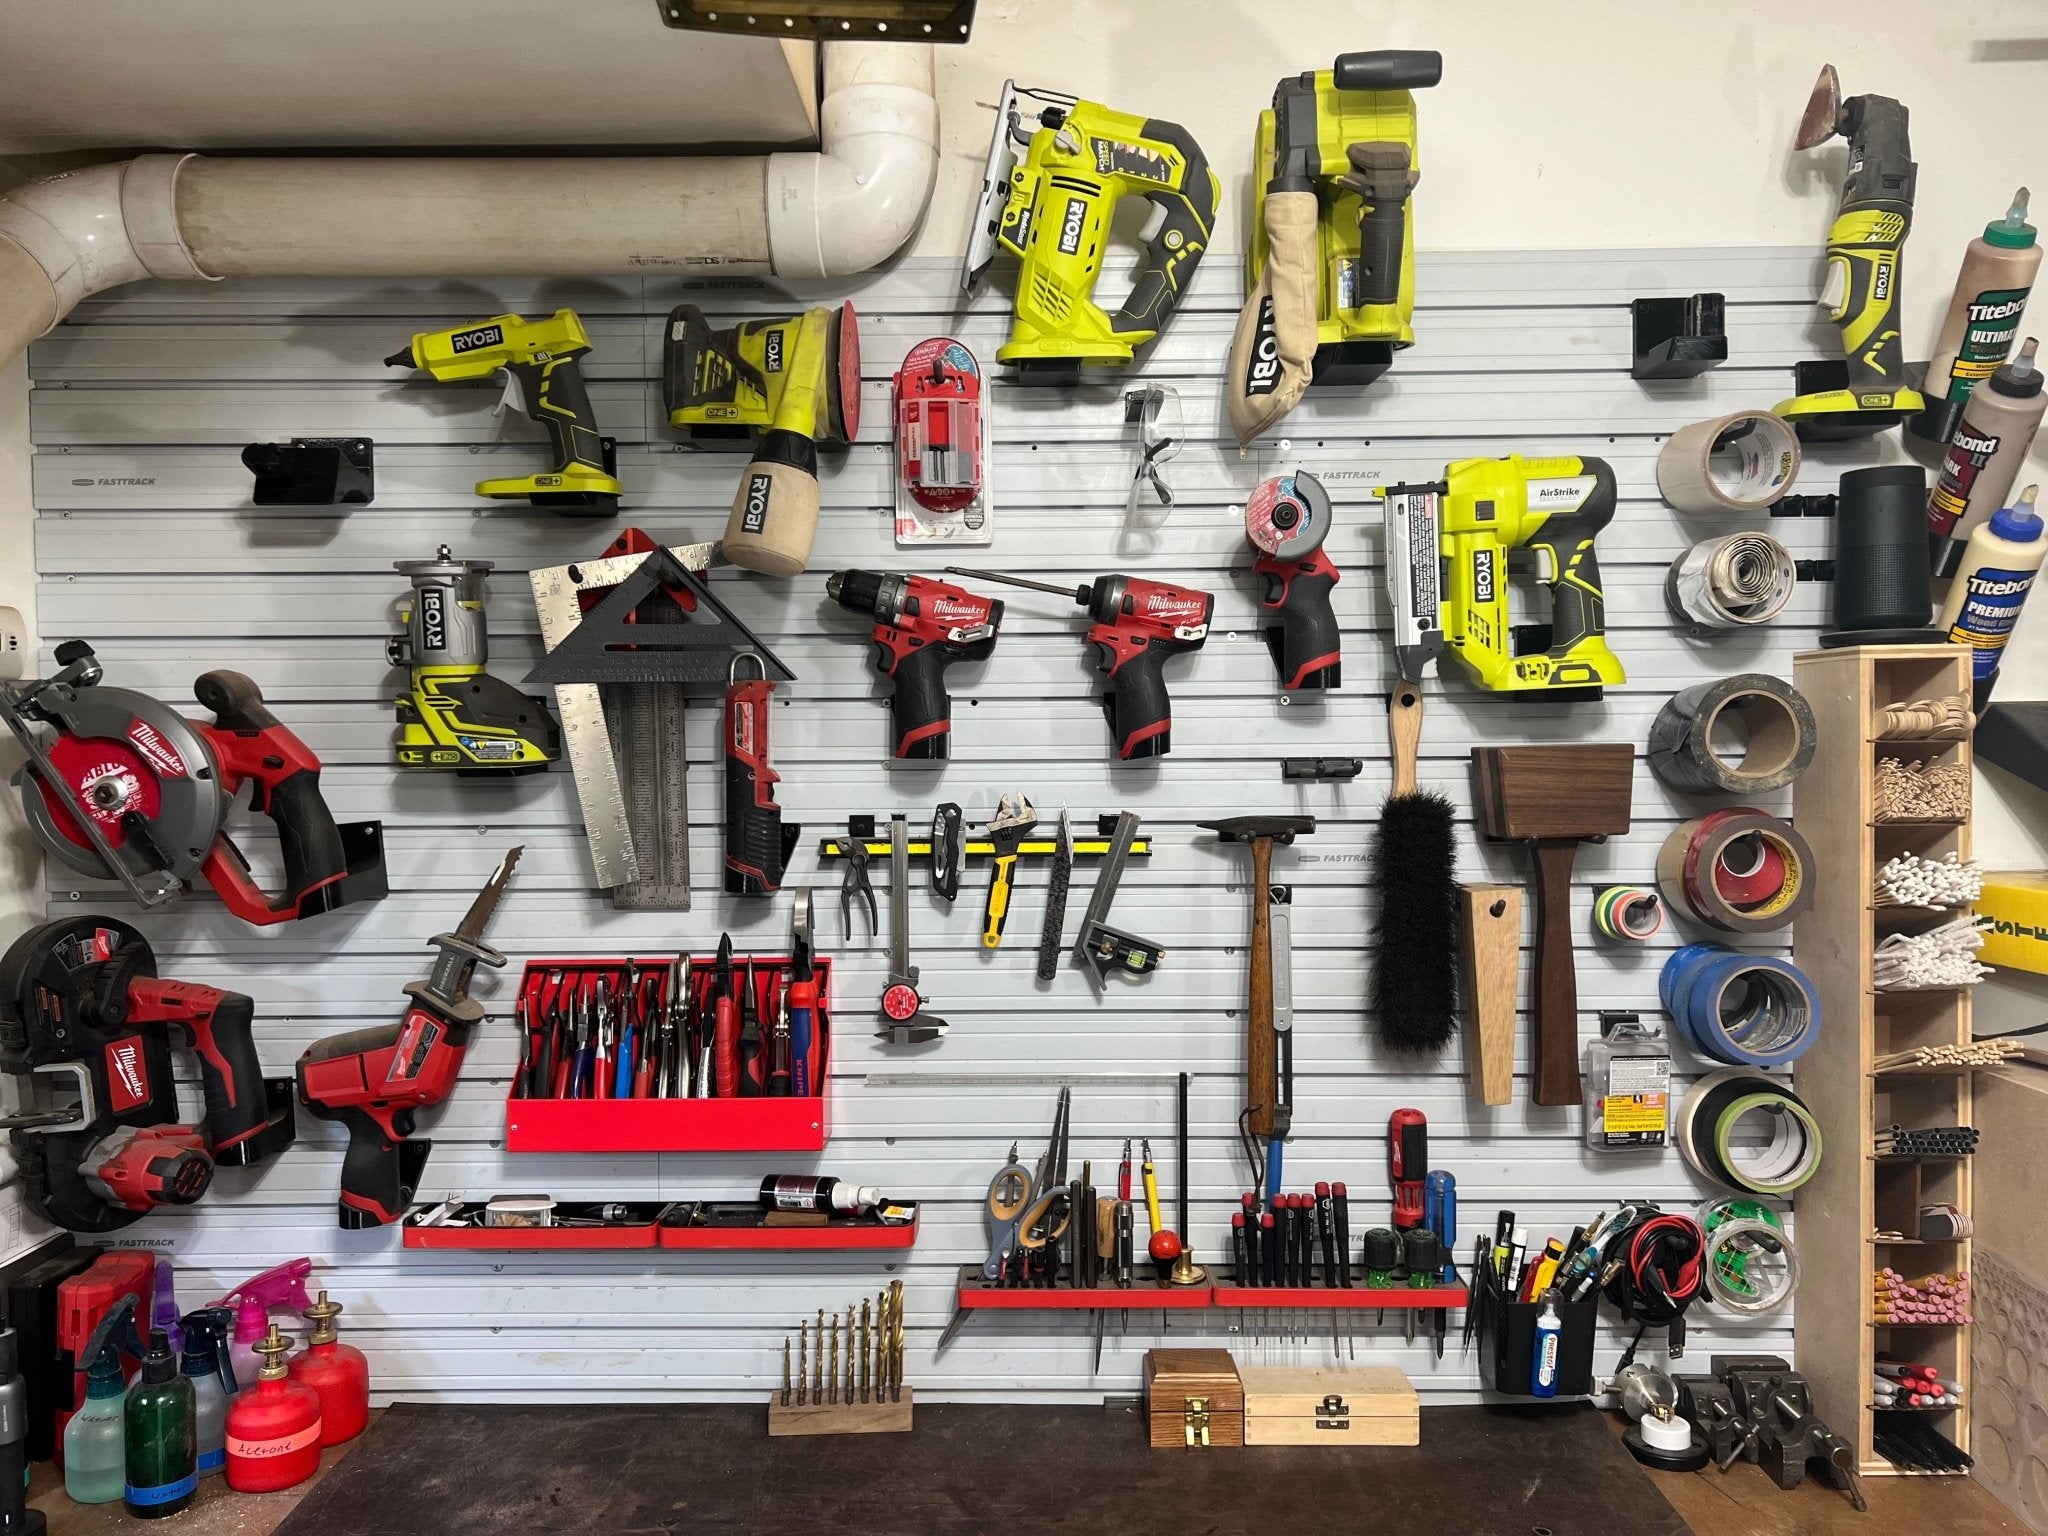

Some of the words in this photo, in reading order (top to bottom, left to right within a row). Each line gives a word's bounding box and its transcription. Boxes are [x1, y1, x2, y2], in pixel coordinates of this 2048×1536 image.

[1097, 141, 1105, 171] MATCH
[1061, 201, 1084, 252] RYOBI
[708, 281, 765, 289] FASTTRACK
[1876, 266, 1889, 298] RYOBI
[454, 328, 500, 350] RYOBI
[1253, 299, 1279, 388] YOBI
[768, 332, 780, 371] RYOBI
[707, 408, 738, 417] ONE+
[98, 478, 156, 486] FASTTRACK
[1323, 471, 1381, 480] FASTTRACK
[1540, 488, 1580, 497] AirStrike
[745, 477, 769, 531] RYOBI
[1477, 553, 1492, 601] RYOBI
[933, 600, 986, 615] Milwaukee
[1148, 594, 1202, 610] Milwaukee
[425, 592, 442, 648] RYOBI
[963, 621, 985, 629] FUEL
[1181, 617, 1203, 625] FUEL
[1967, 615, 1997, 627] Wood
[131, 722, 184, 773] Milwaukee
[438, 955, 456, 990] HACKZALL
[117, 1045, 144, 1099] Milwaukee
[796, 1059, 804, 1096] KNIPE
[119, 1239, 175, 1247] FASTTRACK
[238, 1441, 292, 1456] Acetone
